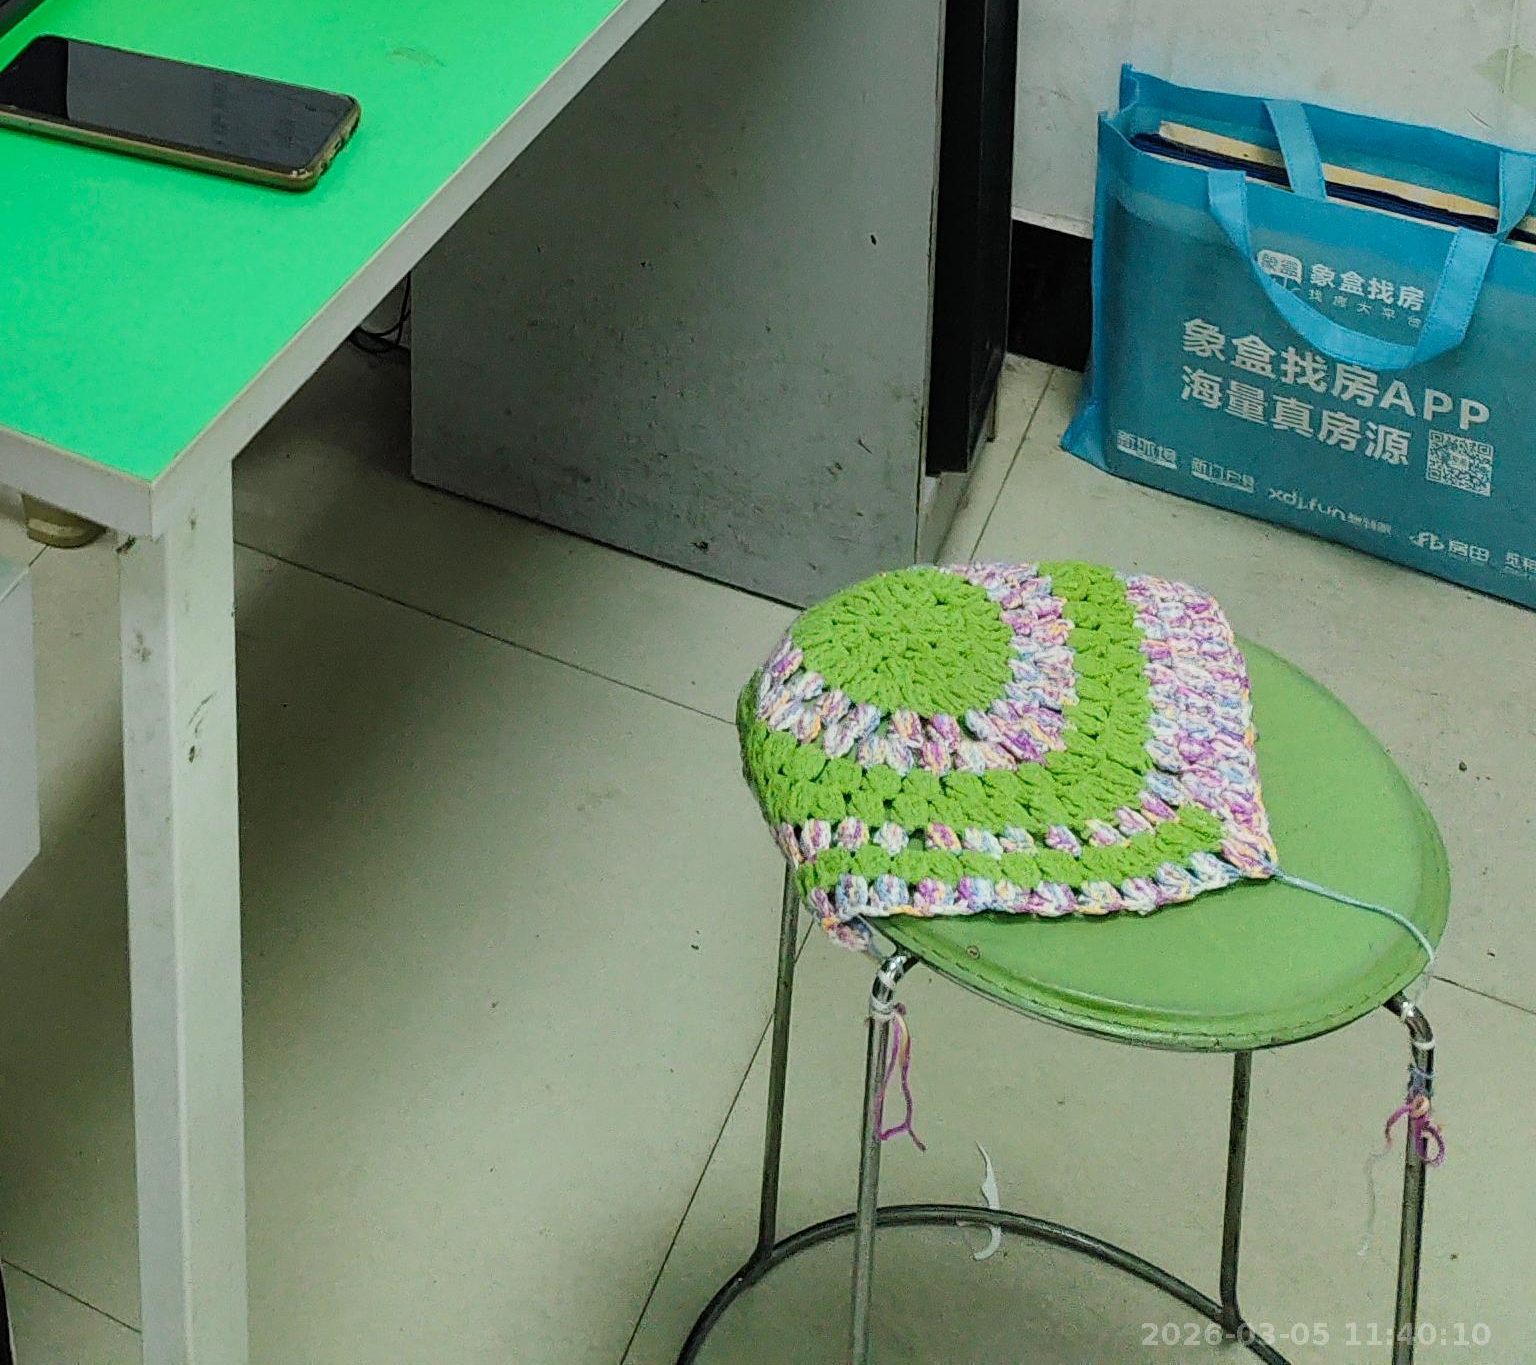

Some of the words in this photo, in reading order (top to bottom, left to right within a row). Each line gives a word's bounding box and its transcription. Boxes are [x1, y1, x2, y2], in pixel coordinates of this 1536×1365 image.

[1310, 263, 1425, 311] 象盒找房
[1180, 366, 1412, 466] 海量真房源
[1182, 316, 1491, 431] 象盒找房APP
